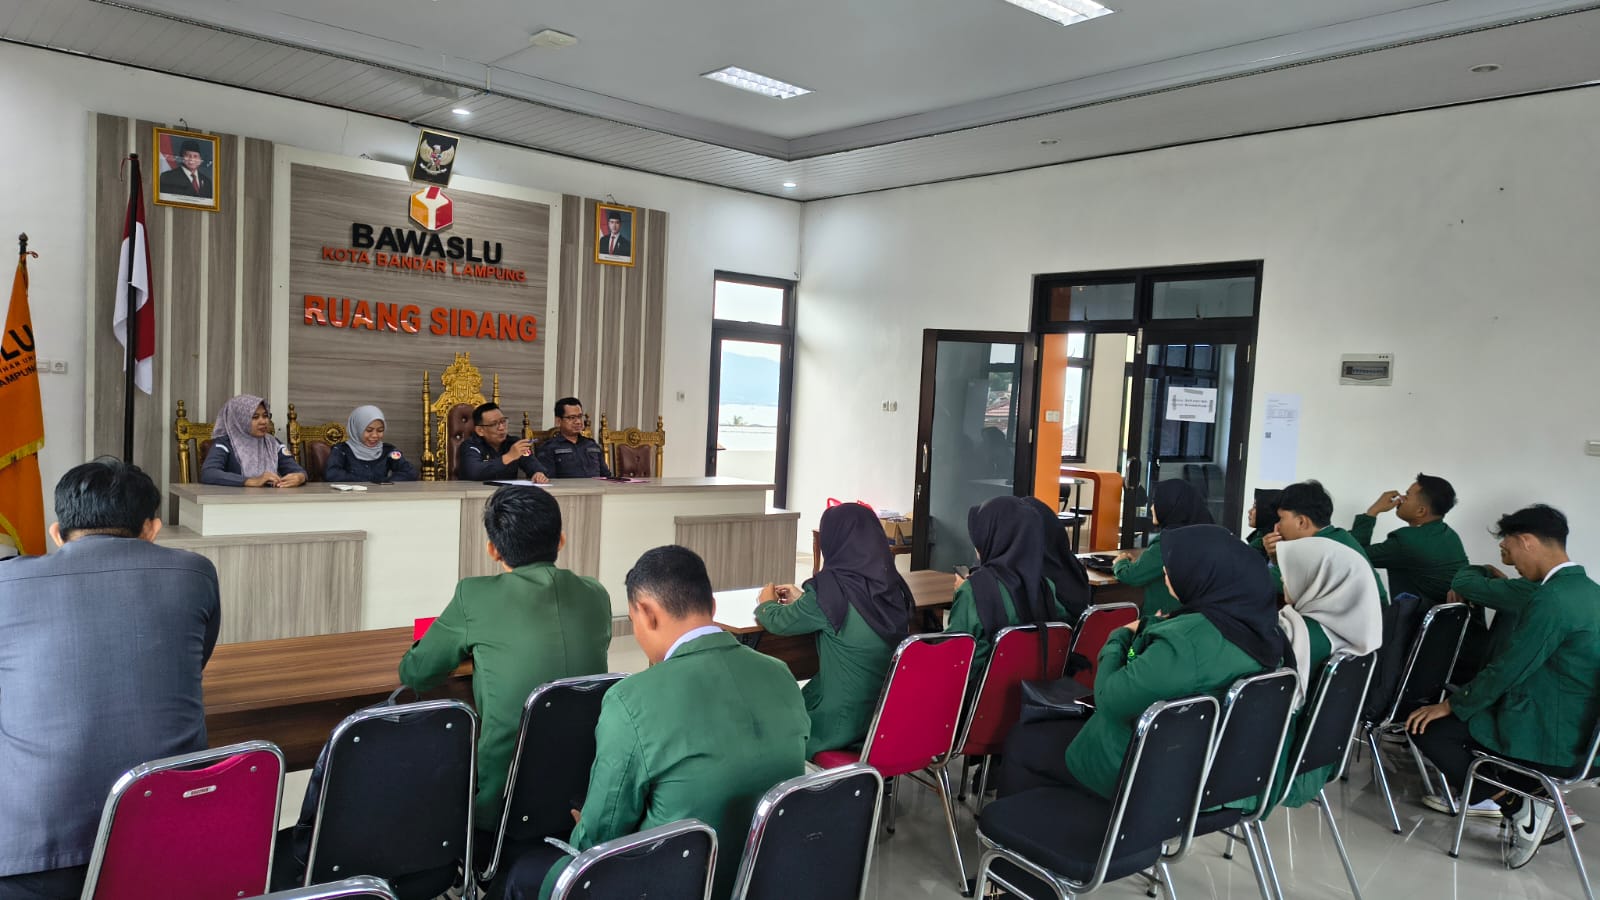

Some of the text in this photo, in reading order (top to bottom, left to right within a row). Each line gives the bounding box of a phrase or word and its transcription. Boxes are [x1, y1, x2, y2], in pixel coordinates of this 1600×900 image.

[322, 246, 526, 282] KOTA BANDAR LAMPUNG
[352, 222, 502, 264] BAWASLU
[304, 295, 537, 342] RUANG SIDANG
